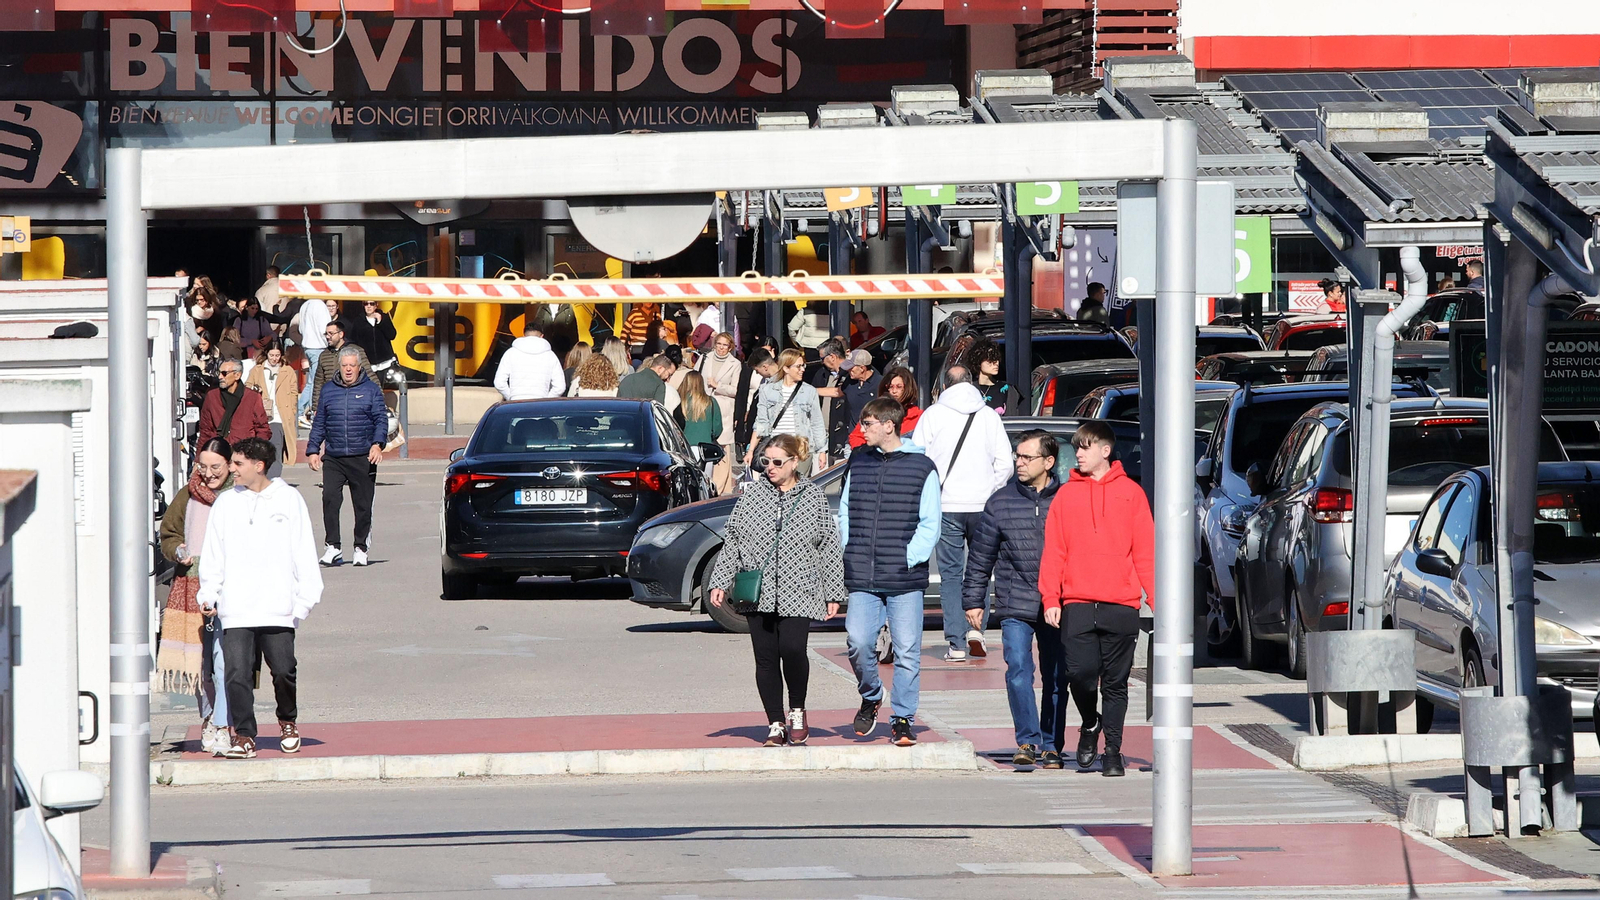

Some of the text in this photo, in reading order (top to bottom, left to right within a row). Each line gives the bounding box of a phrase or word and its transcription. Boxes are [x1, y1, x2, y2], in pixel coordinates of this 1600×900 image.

[109, 17, 802, 94] BIENVENIDOS
[109, 106, 229, 124] BIENVENUE
[235, 106, 353, 125] WELCOME
[498, 103, 610, 125] VÄLKOMNA
[1436, 246, 1463, 258] Elige
[1545, 341, 1600, 353] CADON
[1544, 370, 1600, 378] LANTA BAJ
[524, 490, 583, 502] 8180 JZP
